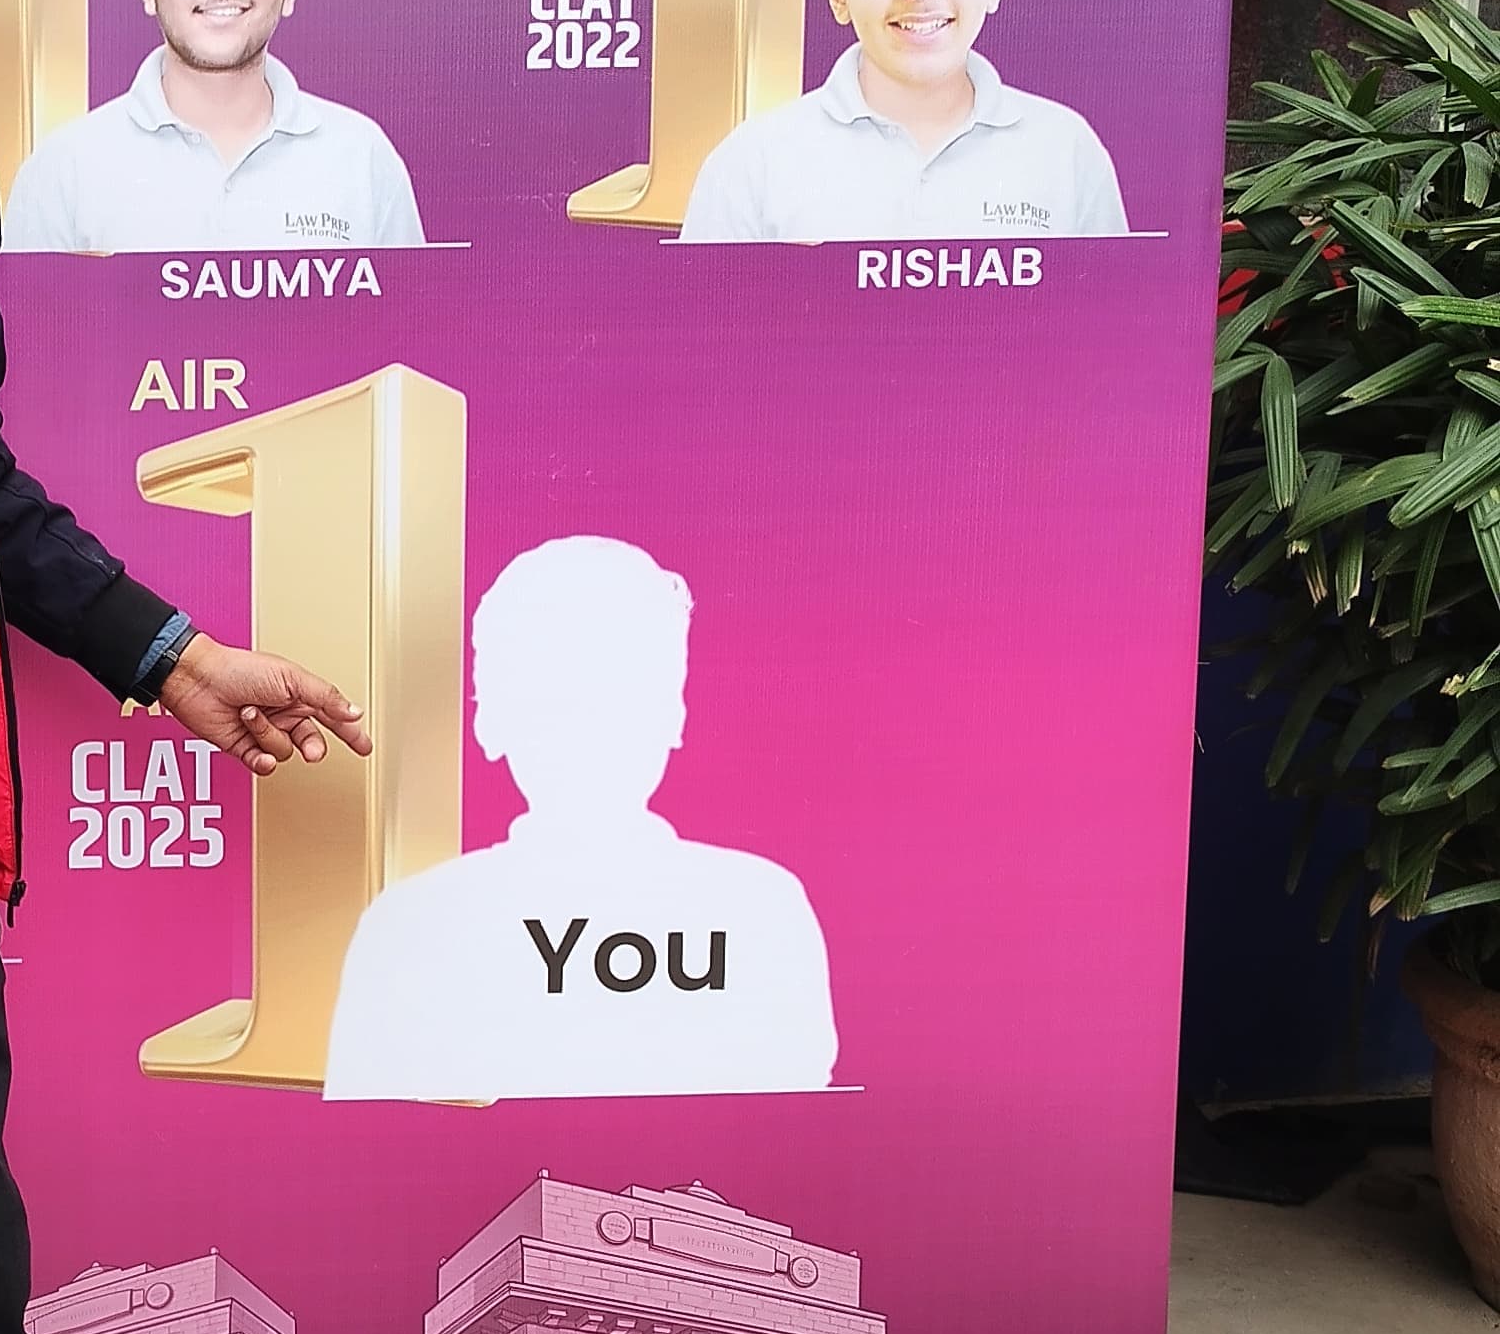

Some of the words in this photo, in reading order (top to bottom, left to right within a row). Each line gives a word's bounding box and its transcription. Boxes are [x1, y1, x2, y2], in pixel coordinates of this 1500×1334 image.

[526, 20, 642, 70] 2022
[161, 257, 382, 299] SAUMYA
[856, 247, 1044, 289] RISHAB
[129, 358, 250, 411] AIR
[72, 739, 223, 804] CLAT
[68, 804, 225, 870] 2025
[523, 917, 728, 995] You
